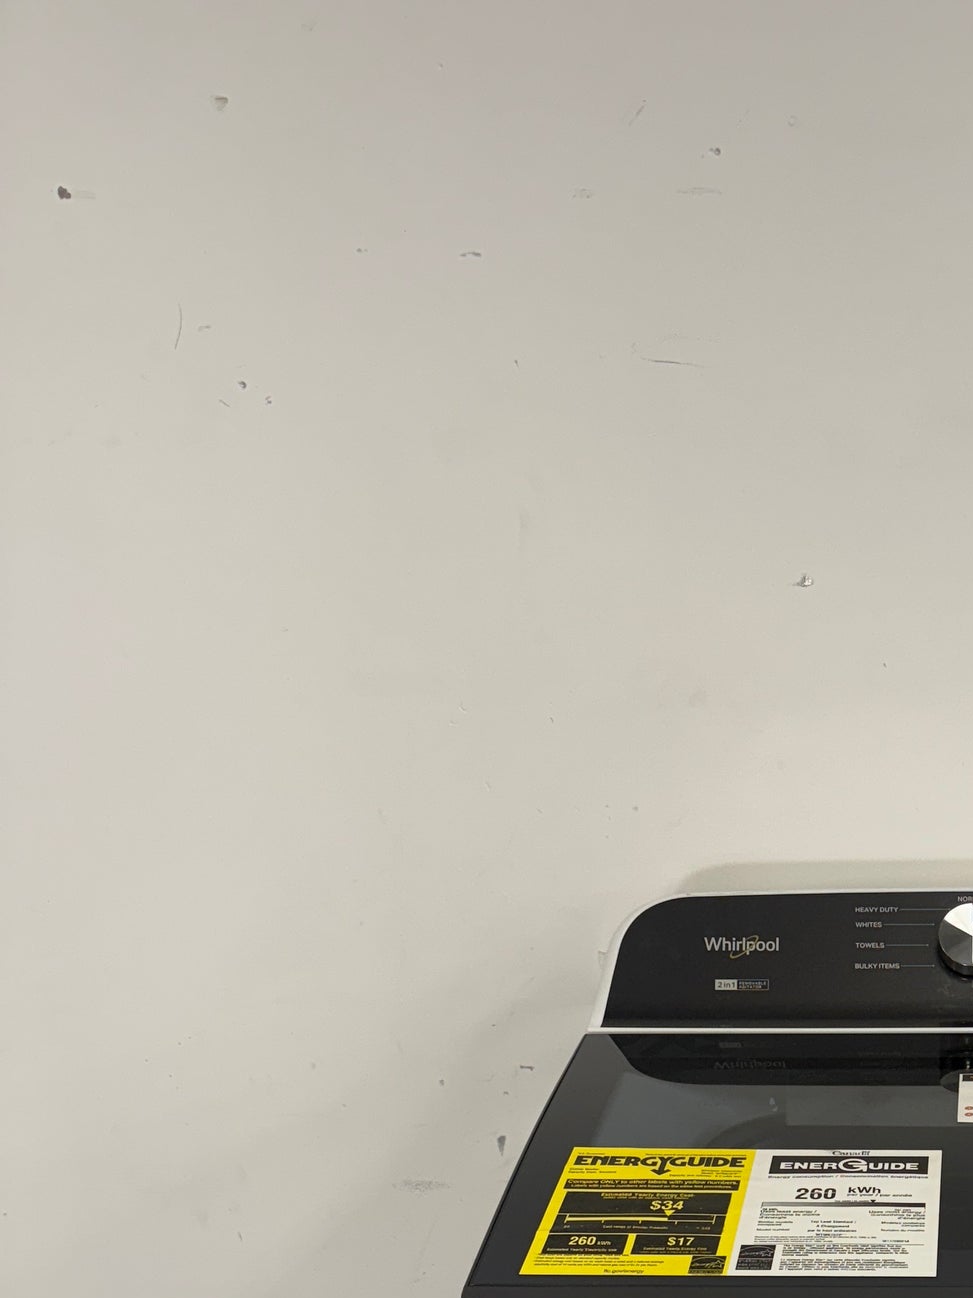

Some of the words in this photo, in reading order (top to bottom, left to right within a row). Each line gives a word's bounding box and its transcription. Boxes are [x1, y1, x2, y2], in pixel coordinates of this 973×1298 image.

[704, 937, 780, 955] Whirlpool
[573, 1155, 747, 1169] ENERGYGUIDE
[780, 1158, 919, 1172] ENERGUIDE
[795, 1188, 836, 1199] 260
[650, 1200, 683, 1210] $34
[568, 1236, 596, 1245] 260
[667, 1237, 694, 1246] $17
